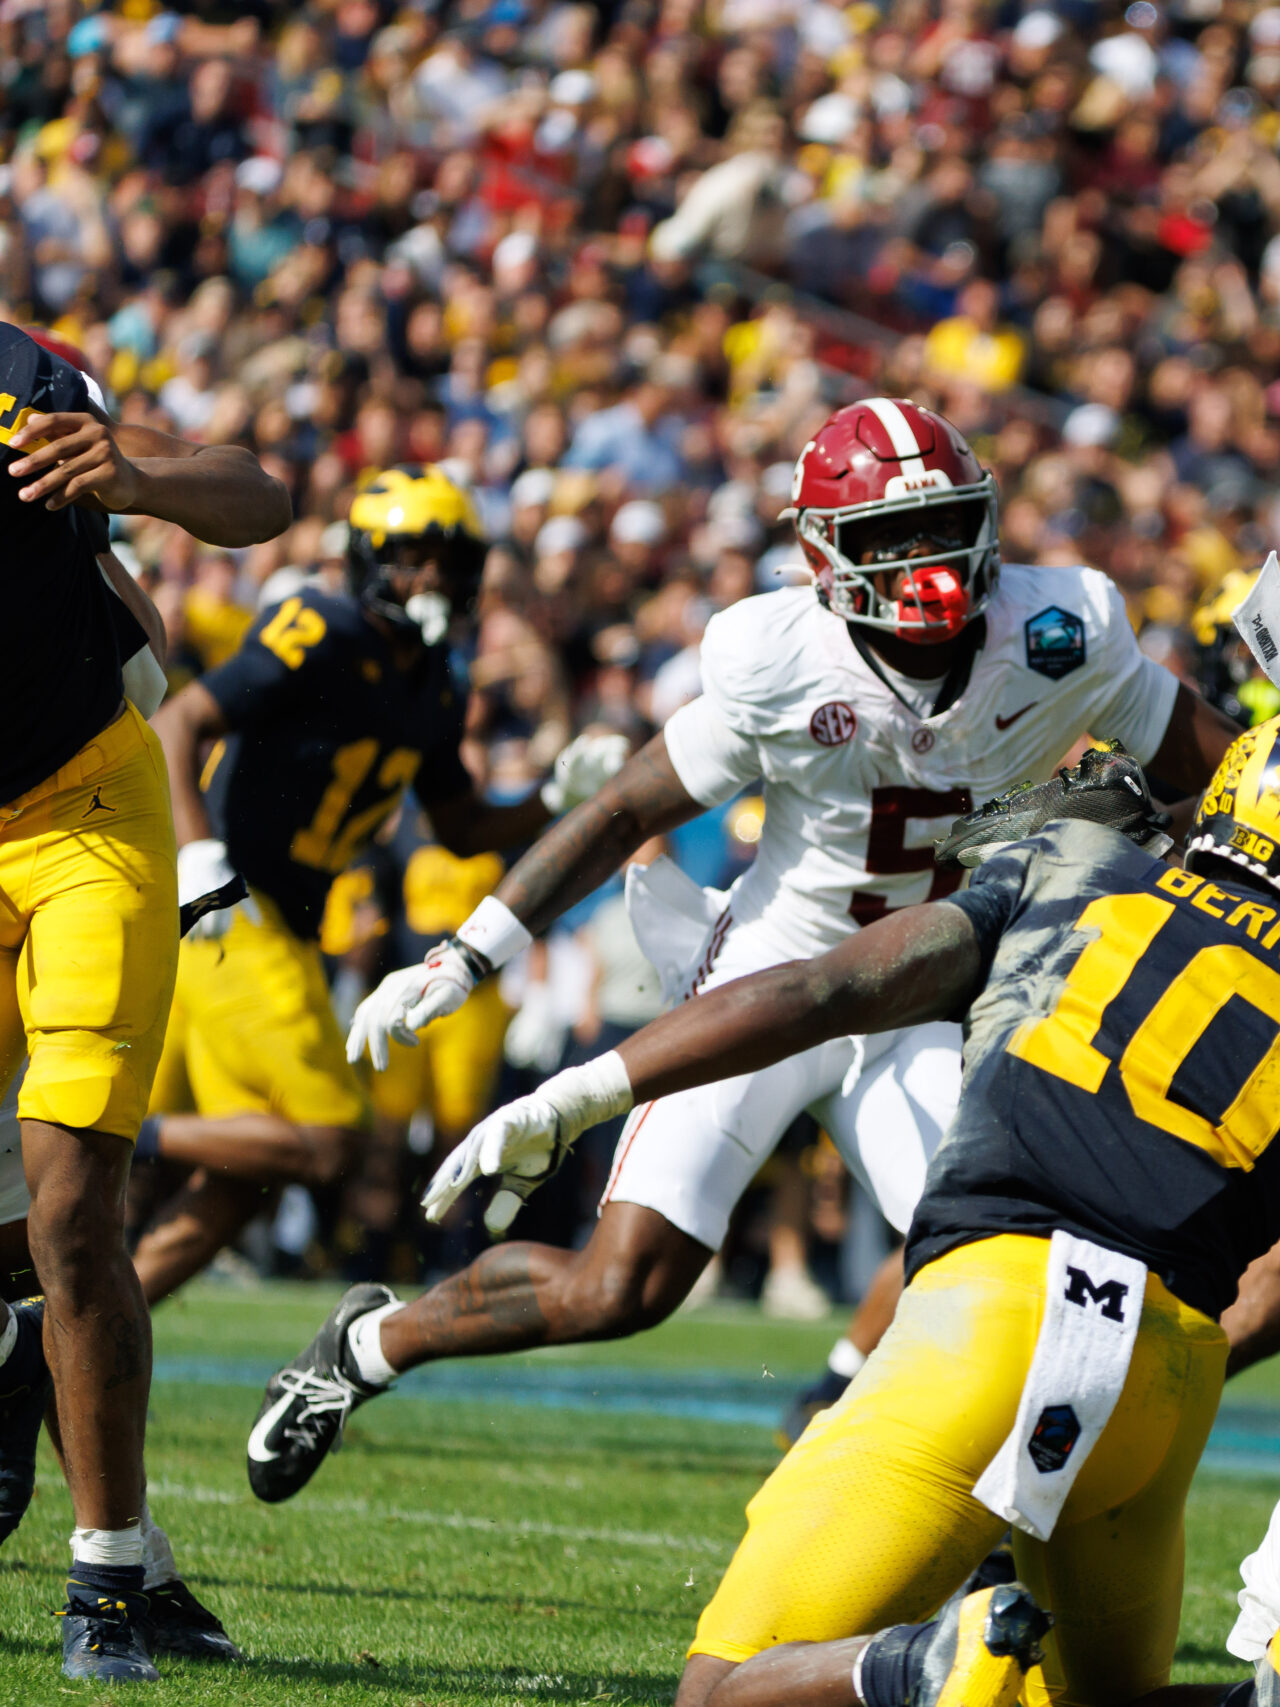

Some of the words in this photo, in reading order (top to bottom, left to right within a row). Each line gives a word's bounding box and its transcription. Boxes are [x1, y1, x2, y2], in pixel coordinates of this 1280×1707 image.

[260, 598, 327, 671] 12
[811, 704, 855, 744] SEC
[289, 736, 423, 875] 12
[849, 787, 974, 926] 5
[1064, 1264, 1130, 1323] M
